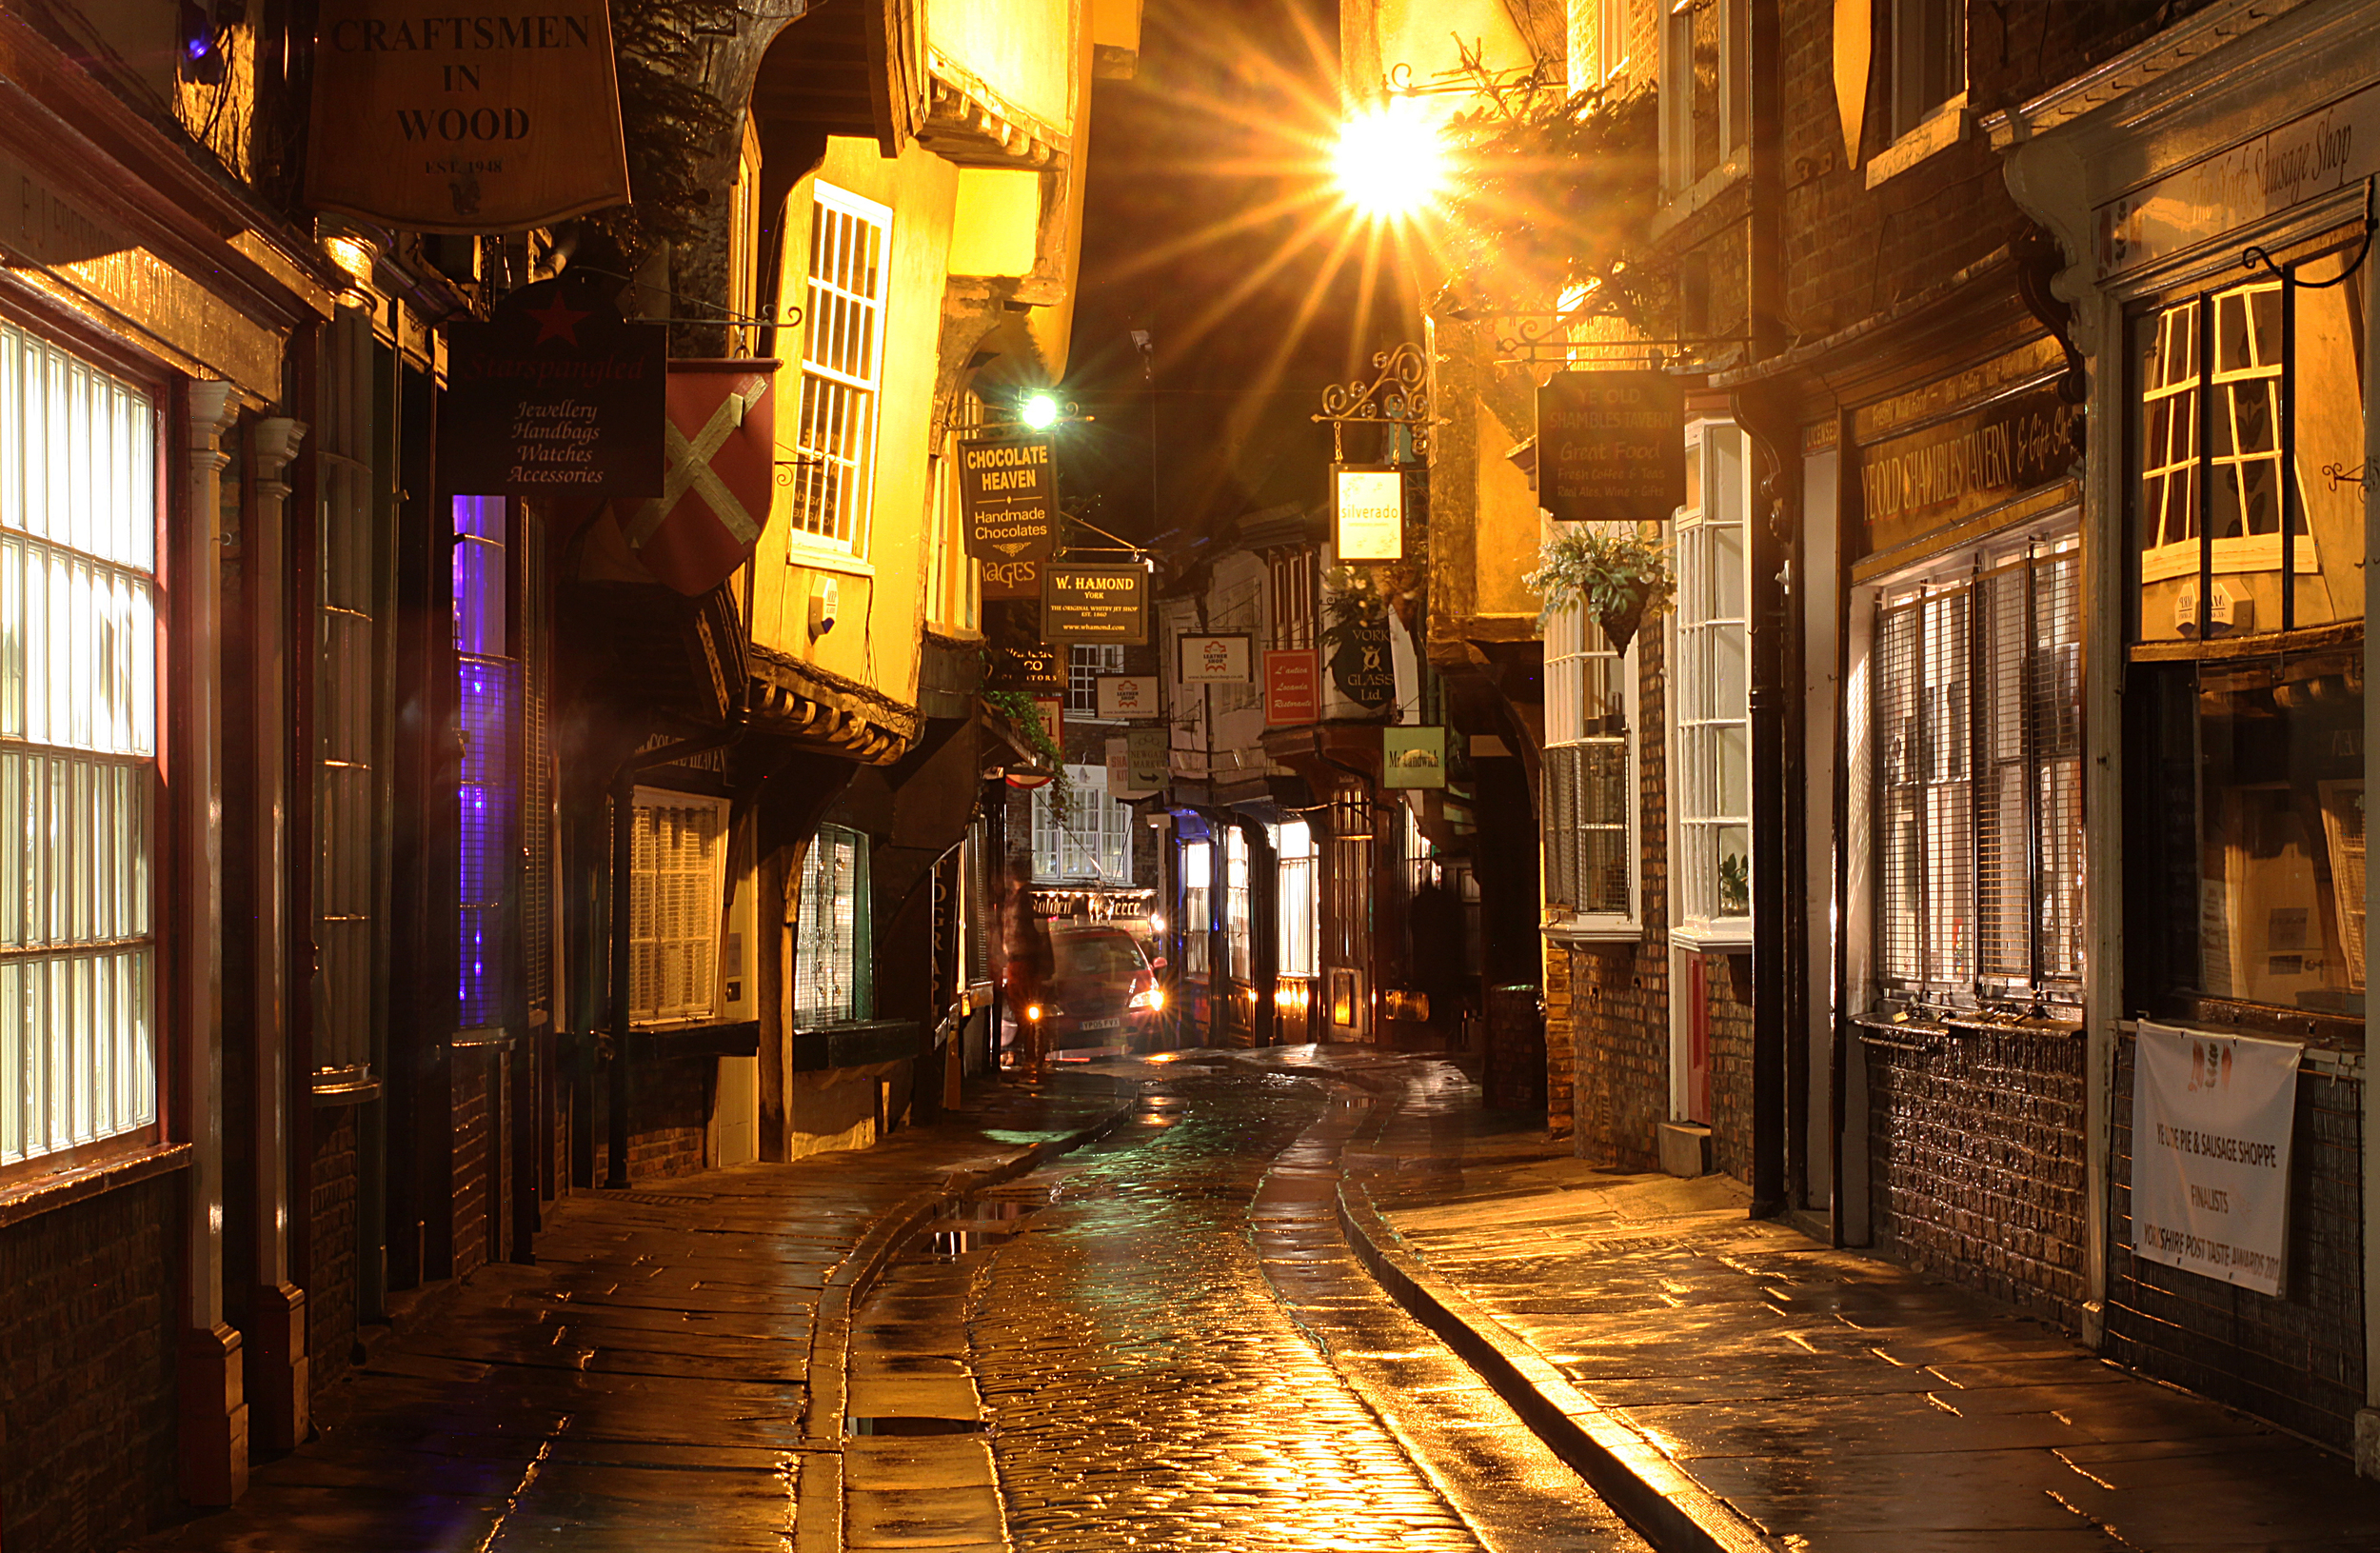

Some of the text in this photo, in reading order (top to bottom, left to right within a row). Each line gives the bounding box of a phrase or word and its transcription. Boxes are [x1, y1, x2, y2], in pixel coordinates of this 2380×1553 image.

[332, 14, 590, 51] CRAFTSMEN
[442, 64, 481, 92] IN
[395, 107, 530, 142] WOOD
[2251, 143, 2310, 207] Sausage
[2311, 108, 2351, 187] Shop
[467, 159, 504, 174] 1948
[1579, 388, 1641, 404] YE OLD
[514, 399, 598, 424] Jewellery
[1549, 411, 1674, 428] SHAMBLES TAVERN
[511, 421, 601, 446] Handbags
[517, 443, 593, 463] Watches
[966, 445, 1048, 469] CHOCOLATE
[1559, 440, 1661, 461] Great Food
[506, 465, 605, 484] Accessories
[1557, 468, 1589, 480] Fresh
[1591, 468, 1624, 480] Coffee
[1642, 468, 1666, 480] Teas
[1860, 464, 1875, 521] YE
[1876, 456, 1901, 516] OLD
[1904, 438, 1963, 510] SHAMBLES
[1964, 420, 2012, 492] TAVERN
[2016, 416, 2027, 473] &
[2029, 412, 2051, 471] Gift
[982, 469, 1037, 491] HEAVEN
[1557, 486, 1577, 498] Real
[1604, 486, 1631, 498] Wine
[1640, 486, 1665, 497] Gifts
[974, 507, 1046, 525] Handmade
[1340, 504, 1398, 519] silverado
[975, 524, 1048, 540] Chocolates
[1055, 574, 1135, 590] W. HAMOND
[1084, 590, 1104, 600] YORK
[1353, 628, 1390, 642] YORK
[1276, 682, 1309, 691] Locanda
[1347, 673, 1395, 687] GLASS
[1360, 688, 1383, 701] Ltd.
[1273, 699, 1313, 708] Ristorante
[1130, 749, 1167, 759] NEWGATE
[1133, 759, 1166, 768] MARKET
[2180, 1128, 2192, 1153] PIE
[2193, 1131, 2200, 1154] &
[2201, 1133, 2237, 1163] SAUSAGE
[2238, 1140, 2277, 1168] SHOPPE
[2191, 1184, 2230, 1214] FINALISTS
[2185, 1234, 2206, 1260] POST
[2206, 1240, 2231, 1267] TASTE
[2231, 1246, 2265, 1277] AWARDS
